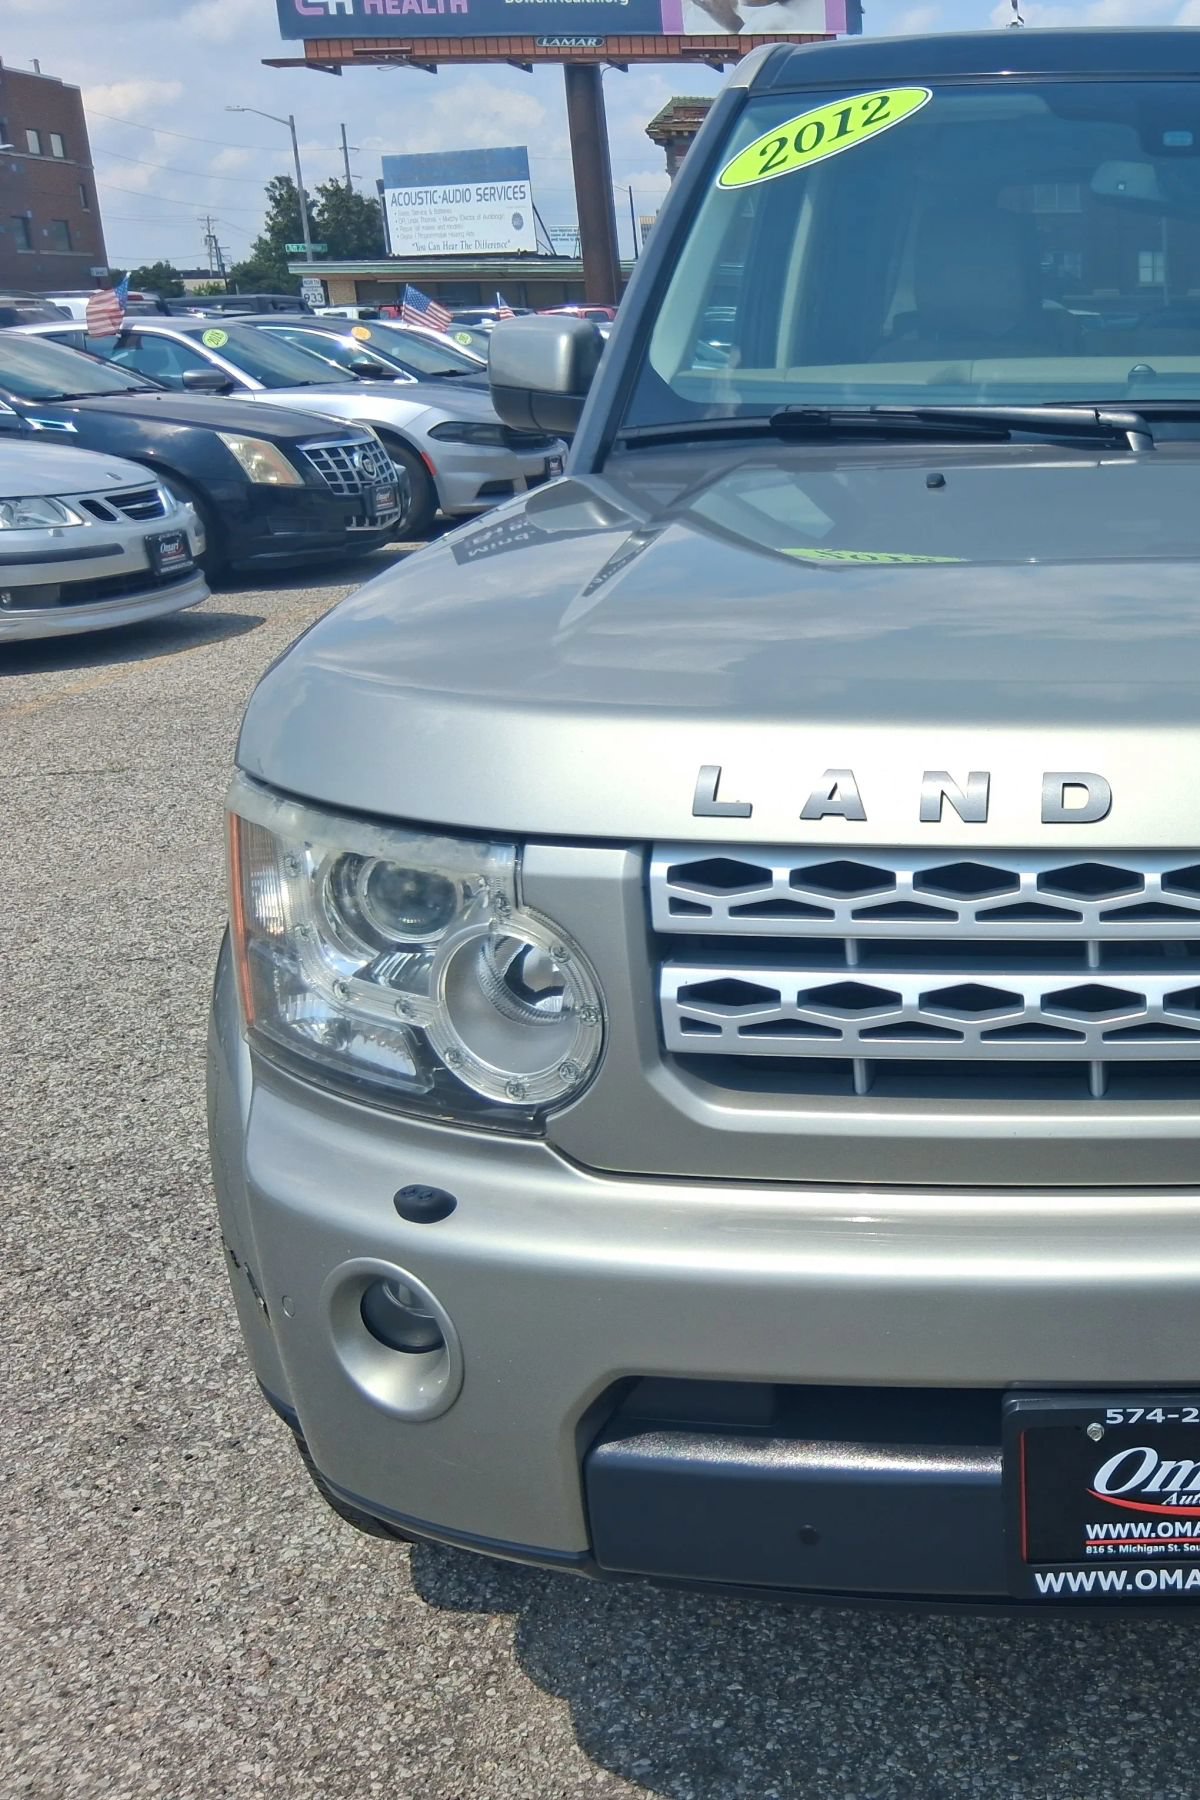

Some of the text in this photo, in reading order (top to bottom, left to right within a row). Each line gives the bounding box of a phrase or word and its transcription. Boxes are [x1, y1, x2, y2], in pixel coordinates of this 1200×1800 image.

[363, 0, 468, 14] HEALTH
[542, 38, 597, 46] LAMAR
[758, 95, 891, 175] 2012
[476, 185, 526, 202] SERVICES
[428, 241, 440, 251] Can
[442, 241, 457, 250] Hear
[460, 240, 472, 250] The
[304, 293, 323, 303] 933
[691, 765, 1112, 824] LAND
[1086, 1545, 1105, 1554] 816
[1107, 1545, 1116, 1553] S.
[1119, 1544, 1165, 1554] Michigan
[1168, 1543, 1180, 1552] St.
